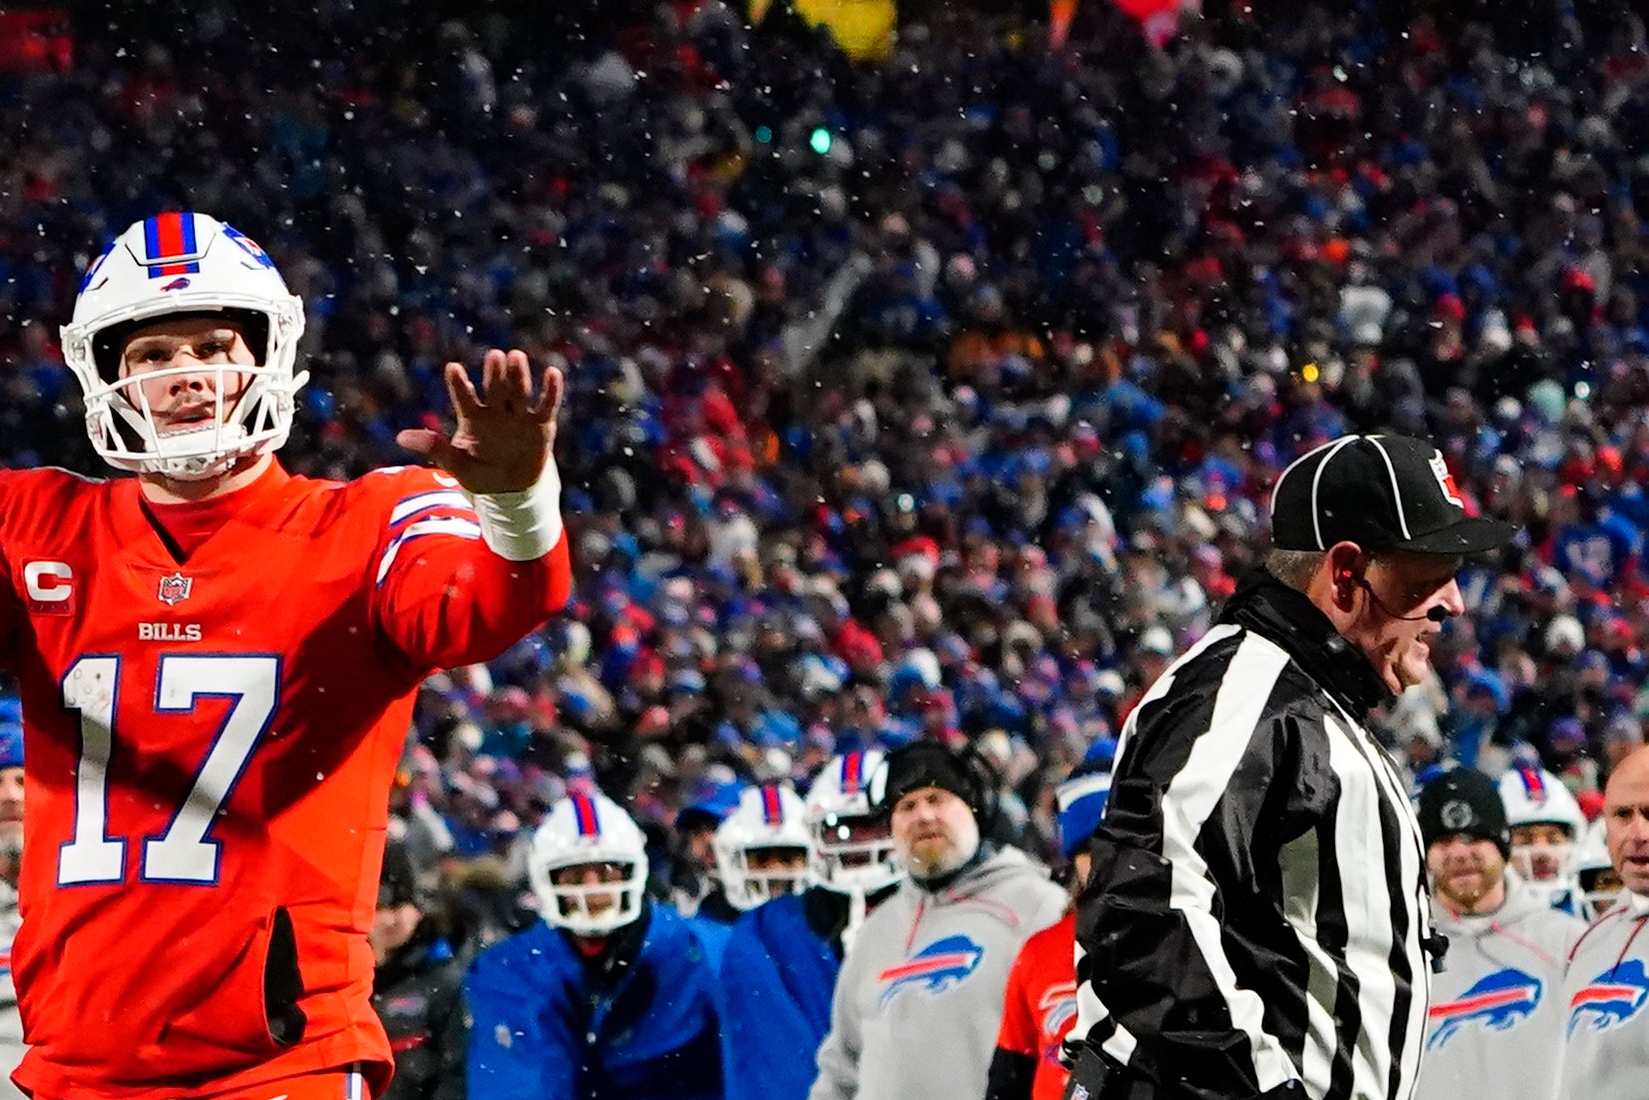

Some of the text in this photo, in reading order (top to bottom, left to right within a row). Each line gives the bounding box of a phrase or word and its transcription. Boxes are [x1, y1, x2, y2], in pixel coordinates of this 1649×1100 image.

[24, 561, 73, 602] C
[138, 622, 202, 641] BILLS
[56, 653, 282, 887] 17
